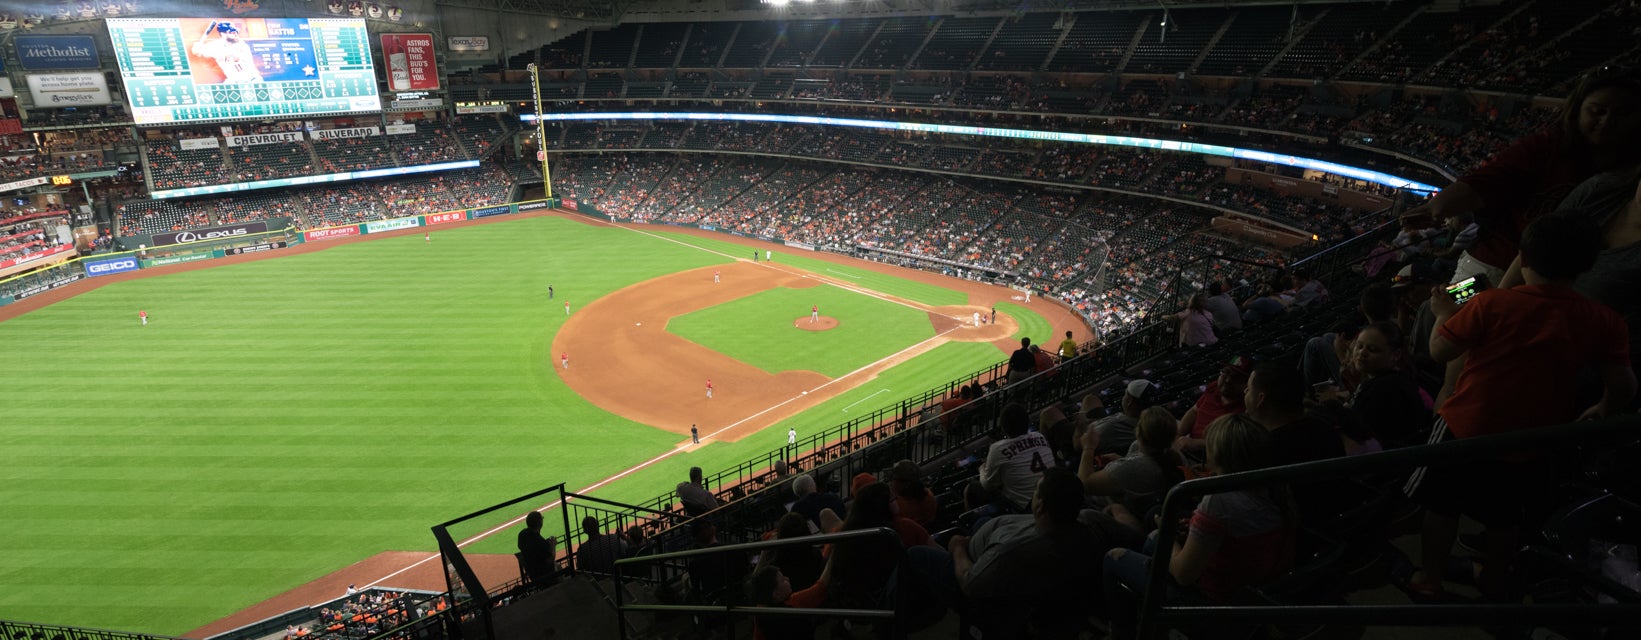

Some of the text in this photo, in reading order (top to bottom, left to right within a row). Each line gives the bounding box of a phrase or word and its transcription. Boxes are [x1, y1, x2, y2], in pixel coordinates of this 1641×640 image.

[406, 39, 430, 47] ASTROS
[25, 45, 91, 57] Methodist
[408, 46, 425, 54] FANS,
[233, 132, 297, 146] CHEVROLET
[318, 127, 373, 140] SILVERADO
[197, 228, 248, 240] LEXUS
[309, 229, 329, 238] ROOT
[330, 227, 354, 235] SPORTS
[89, 260, 135, 273] GEICO
[1001, 436, 1050, 459] SPRINGE
[1029, 451, 1049, 473] 4
